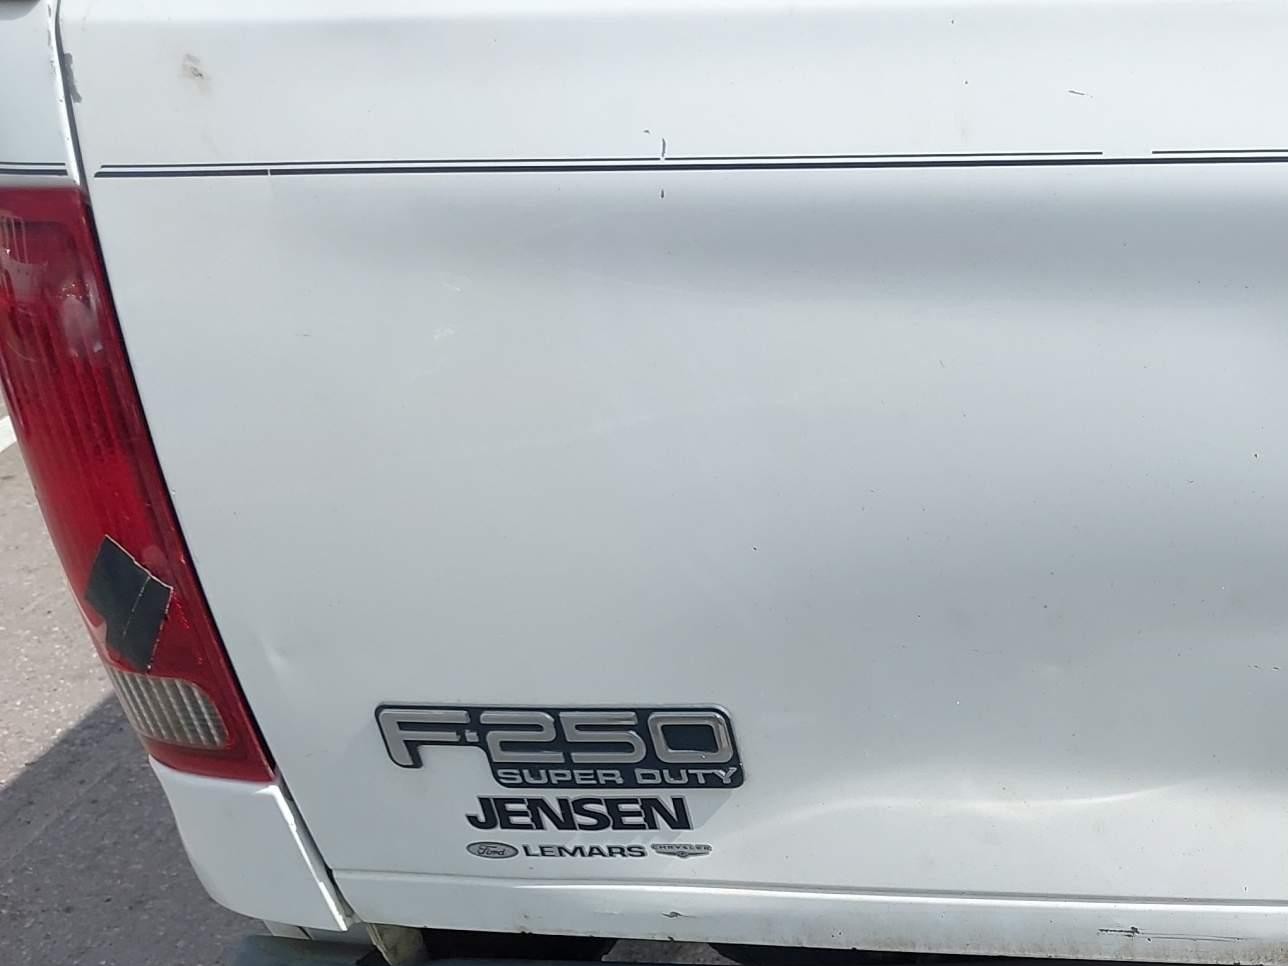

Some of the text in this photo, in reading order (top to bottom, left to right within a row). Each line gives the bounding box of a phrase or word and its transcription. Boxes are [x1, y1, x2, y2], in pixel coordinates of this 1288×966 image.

[496, 766, 740, 785] SUPER DUTY
[466, 796, 692, 830] JENSEN
[475, 846, 506, 857] Ford
[522, 844, 648, 858] LEMARS
